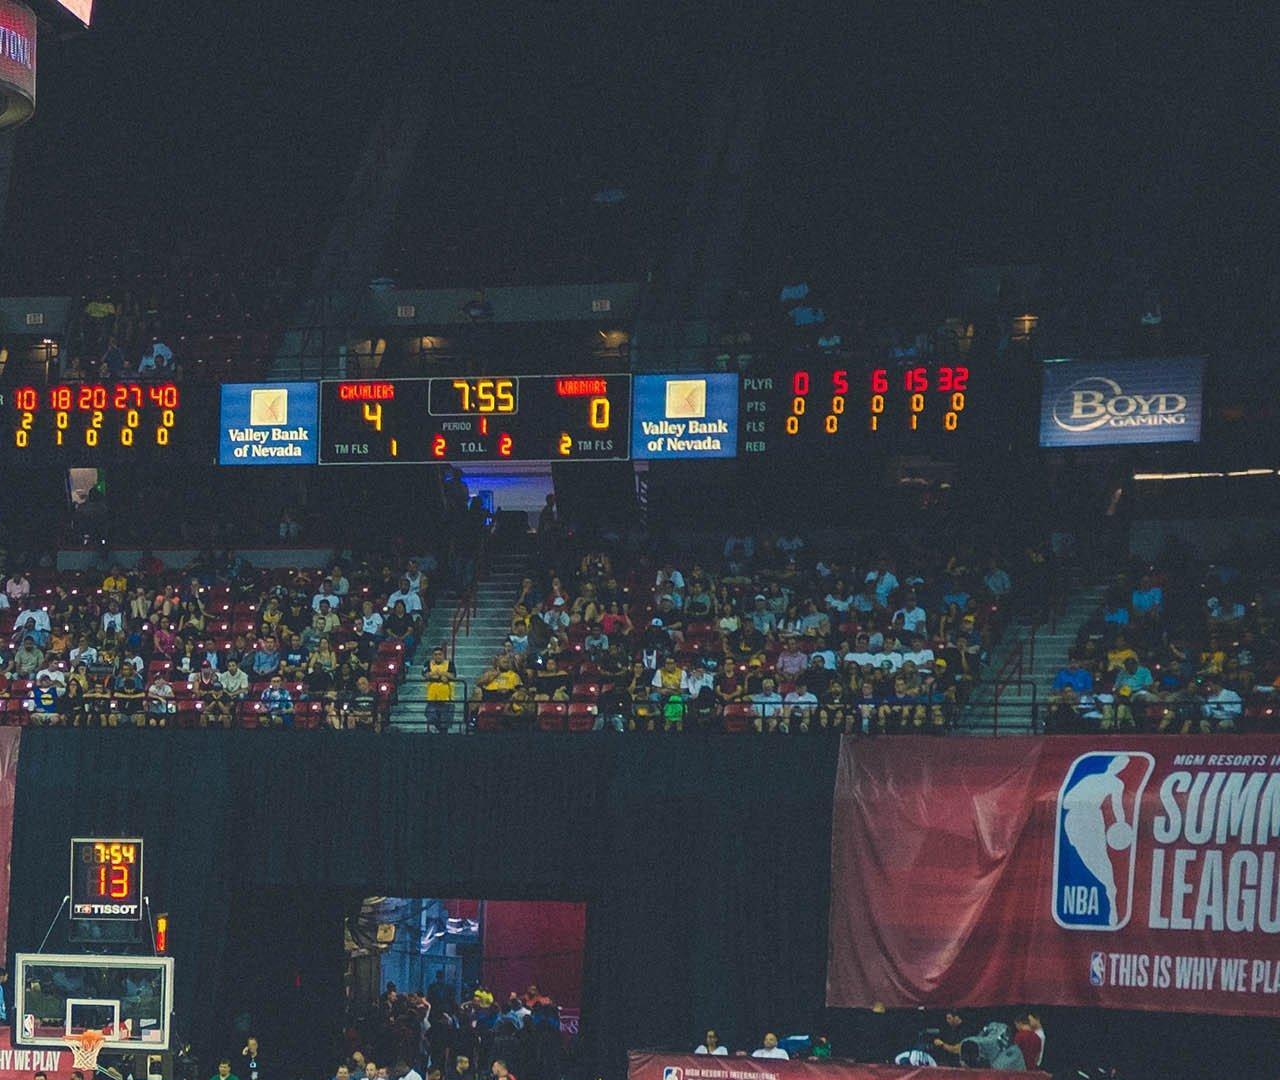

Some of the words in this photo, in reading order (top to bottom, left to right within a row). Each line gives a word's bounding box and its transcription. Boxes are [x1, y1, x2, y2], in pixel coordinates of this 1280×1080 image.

[744, 379, 773, 390] PLYR
[794, 371, 809, 395] 0
[832, 370, 848, 394] 5
[872, 369, 888, 393] 6
[905, 367, 928, 392] 15
[938, 367, 969, 391] 32
[16, 389, 36, 410] 10
[52, 388, 71, 409] 18
[79, 387, 106, 408] 20
[115, 386, 141, 408] 27
[150, 386, 177, 408] 40
[453, 379, 515, 412] 7:55
[746, 401, 767, 412] PTS
[793, 396, 805, 415] 0
[832, 396, 844, 414] 0
[872, 394, 884, 413] 0
[912, 393, 924, 412] 0
[952, 392, 964, 411] 0
[1071, 391, 1187, 418] BOYD
[22, 413, 33, 429] 2
[57, 412, 68, 429] 0
[92, 412, 103, 428] 2
[127, 410, 138, 428] 0
[163, 410, 174, 427] 0
[364, 403, 382, 431] 4
[591, 398, 610, 429] 0
[746, 422, 765, 432] FLS
[786, 416, 798, 434] 0
[945, 411, 957, 430] 0
[1109, 414, 1186, 427] GAMING
[16, 430, 27, 447] 0
[86, 429, 97, 446] 0
[121, 428, 132, 446] 0
[157, 427, 168, 445] 0
[229, 428, 269, 443] Valley
[272, 427, 308, 441] Bank
[642, 421, 686, 437] Valley
[688, 419, 729, 434] Bank
[234, 445, 249, 457] of
[252, 444, 301, 457] Nevada
[335, 444, 348, 454] TM
[351, 444, 368, 454] FLS
[391, 439, 397, 456] 1
[434, 438, 446, 456] 2
[501, 437, 512, 455] 2
[560, 434, 572, 455] 2
[577, 441, 591, 450] TM
[595, 440, 613, 450] FLS
[648, 438, 663, 451] of
[667, 436, 721, 451] Nevada
[746, 441, 766, 452] REB
[1174, 755, 1206, 766] MGM
[1208, 755, 1267, 766] RESORTS
[95, 843, 135, 864] 7:54
[100, 865, 128, 898] 13
[92, 905, 137, 914] TISSOT
[1063, 886, 1099, 915] NBA
[1109, 953, 1149, 987] THIS
[1153, 955, 1171, 989] IS
[1175, 957, 1218, 990] WHY
[1221, 958, 1247, 992] WE
[14, 1050, 31, 1071] WE
[33, 1050, 60, 1071] PLAY
